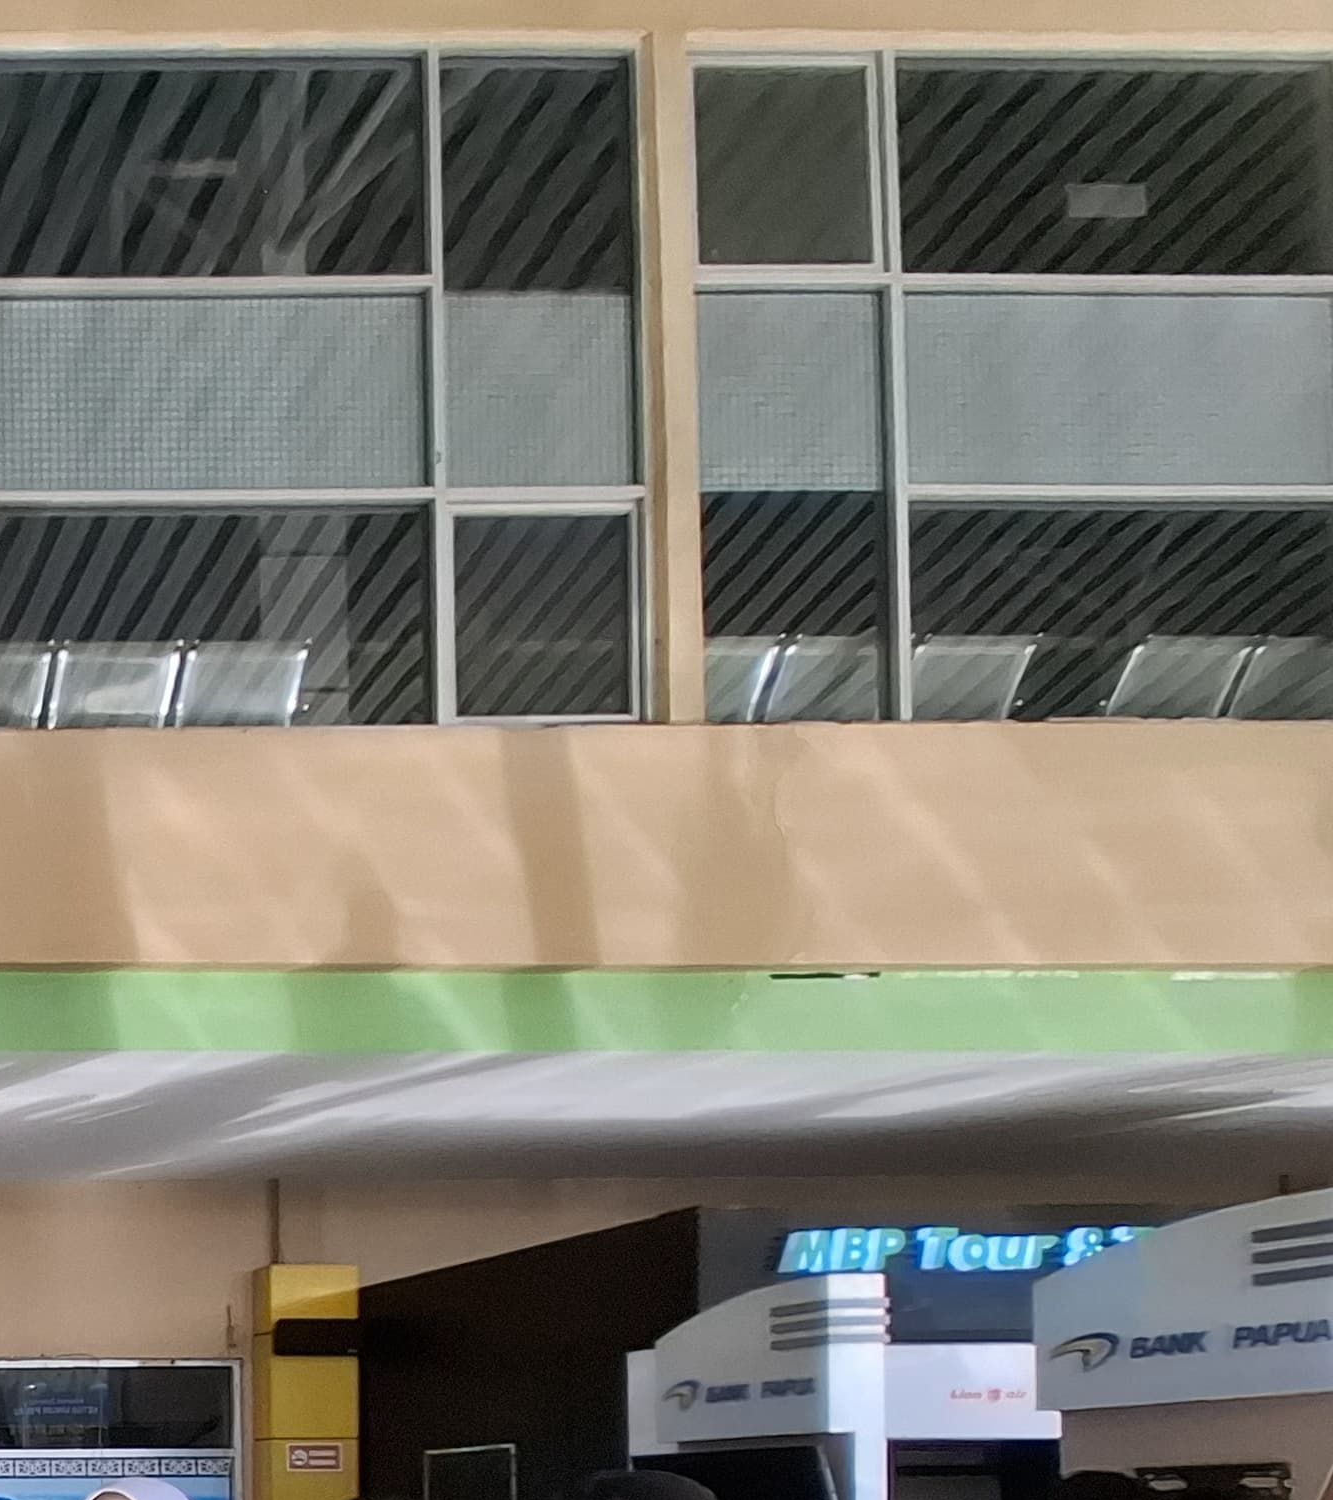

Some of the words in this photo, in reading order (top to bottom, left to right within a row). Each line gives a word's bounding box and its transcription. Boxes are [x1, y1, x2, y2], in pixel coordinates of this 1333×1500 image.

[777, 1227, 906, 1273] MBP
[915, 1226, 1060, 1272] Tour
[1130, 1331, 1209, 1358] BANK
[1233, 1319, 1332, 1348] PAPUA
